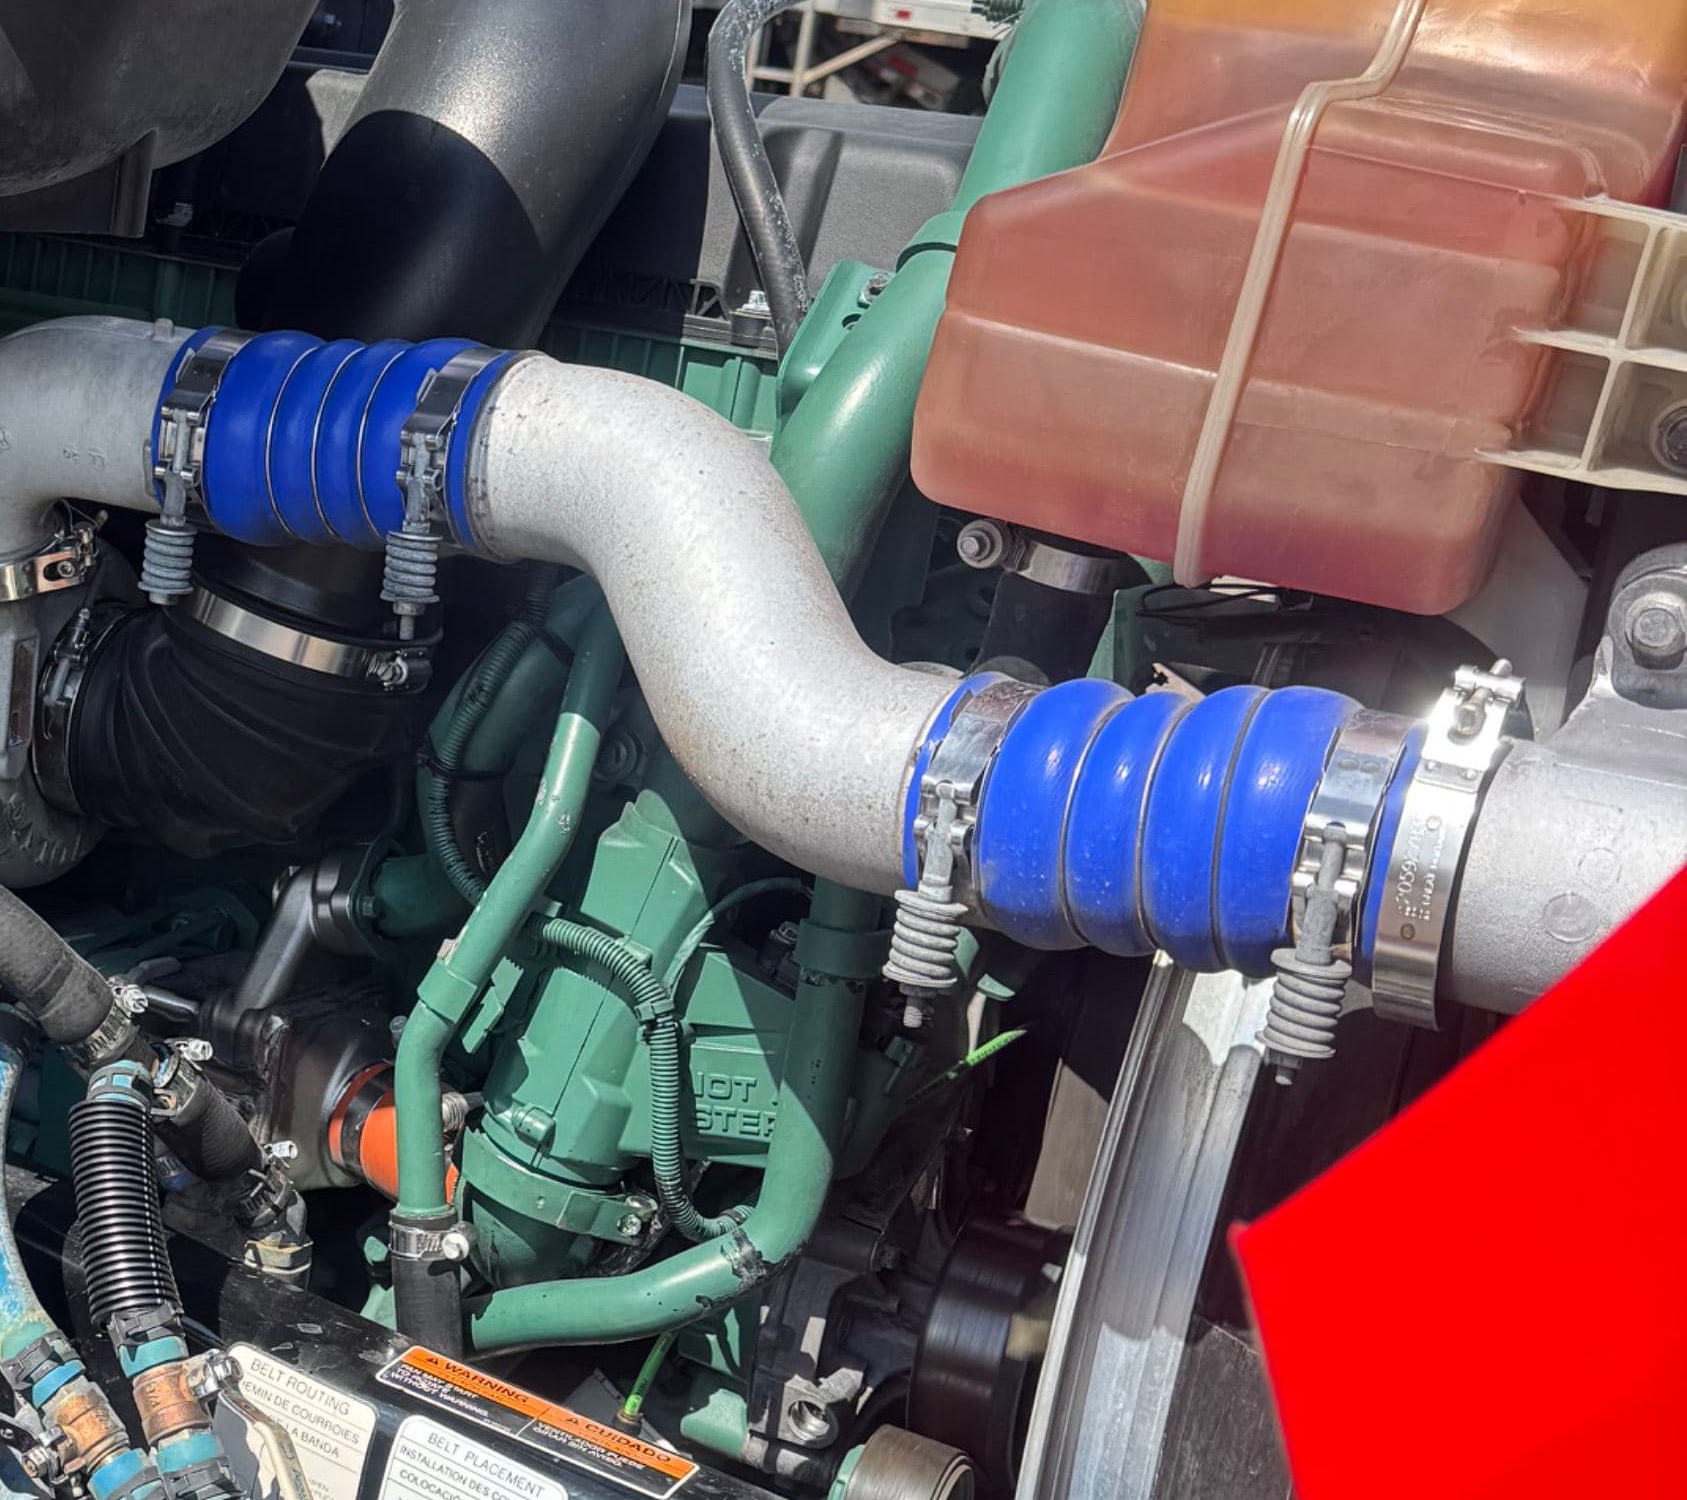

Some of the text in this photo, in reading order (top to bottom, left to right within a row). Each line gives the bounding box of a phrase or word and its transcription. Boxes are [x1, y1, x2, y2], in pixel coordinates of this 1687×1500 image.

[250, 1357, 351, 1417] BELT ROUTING
[444, 1361, 530, 1404] WARNING
[273, 1393, 291, 1412] DE
[291, 1403, 361, 1446] COURROIES
[300, 1431, 340, 1459] BANDA
[583, 1420, 672, 1464] CUIDADO
[399, 1444, 468, 1487] INSTALLATION
[468, 1476, 492, 1498] DES
[426, 1431, 546, 1498] BELT PLACEMENT
